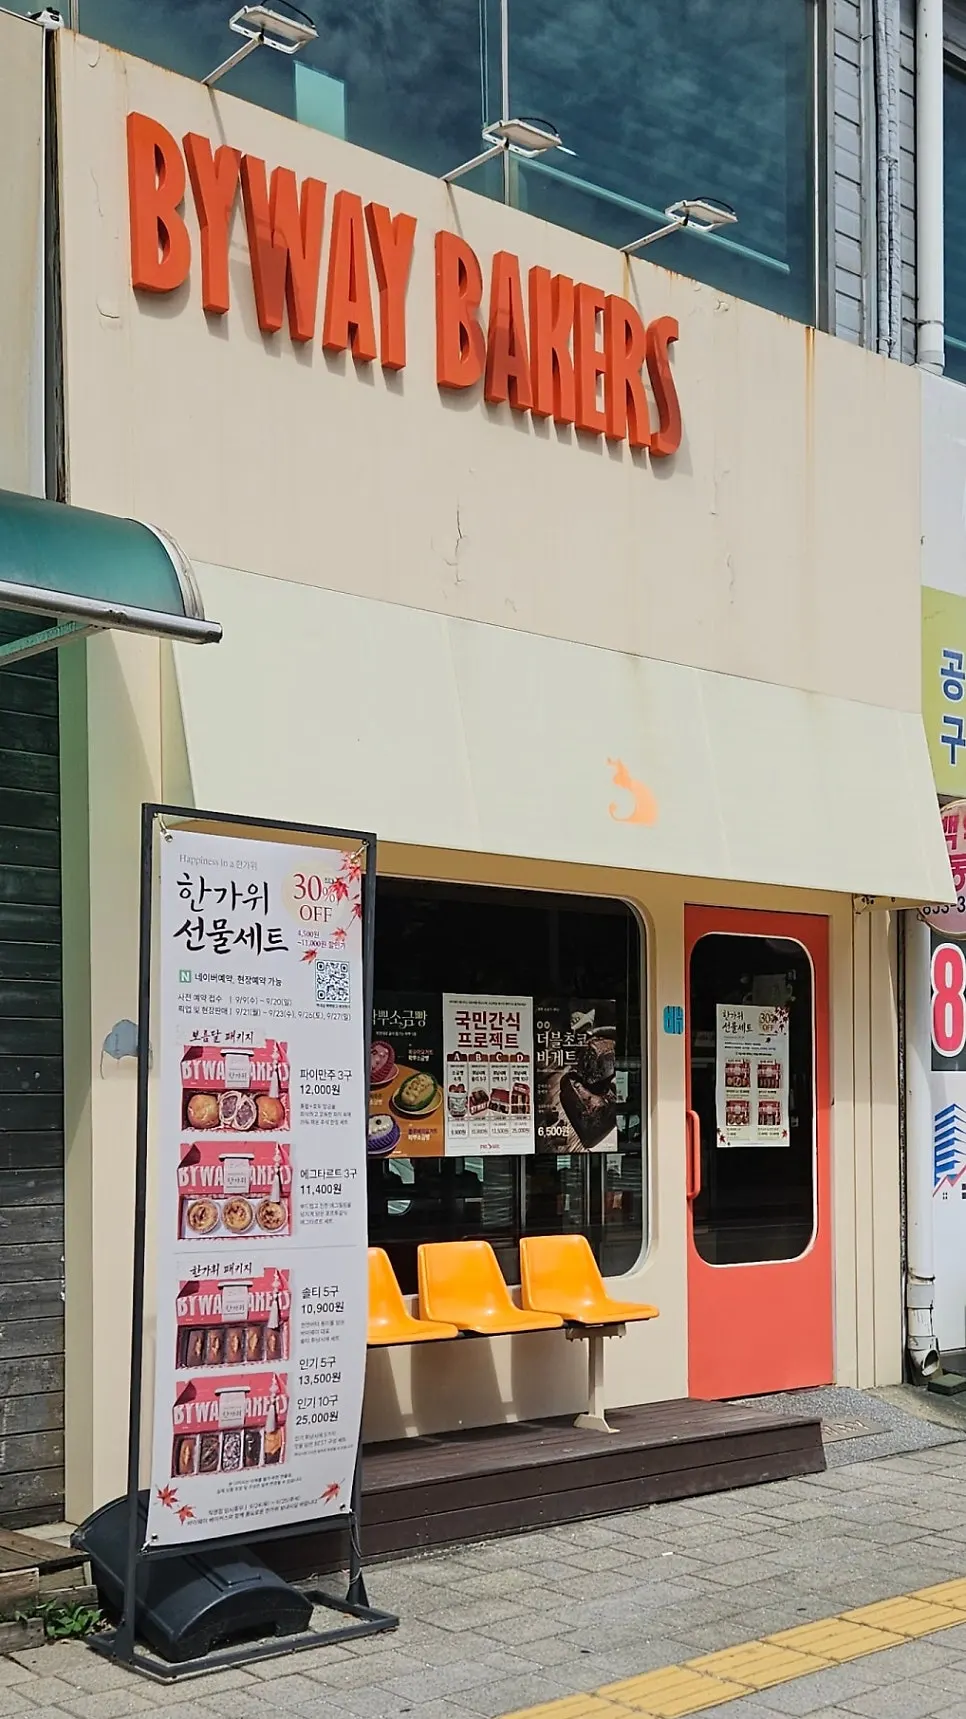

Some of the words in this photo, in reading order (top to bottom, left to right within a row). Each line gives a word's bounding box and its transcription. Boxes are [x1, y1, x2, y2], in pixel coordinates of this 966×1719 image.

[126, 111, 418, 371] BYWAY
[435, 229, 680, 459] BAKERS
[179, 854, 219, 866] Happiness
[177, 872, 268, 916] 한가위
[293, 873, 336, 903] 30%
[300, 904, 333, 923] OFF
[173, 916, 289, 957] 선물세트
[237, 975, 266, 986] 현장예약
[268, 977, 282, 987] 가능
[178, 993, 191, 1002] 사전
[932, 945, 965, 1054] 8
[455, 1010, 520, 1032] 국민간식
[722, 1010, 744, 1021] 한가위
[722, 1021, 754, 1034] 선물세트
[189, 1028, 222, 1044] 보름달
[224, 1029, 254, 1045] 패키지
[457, 1031, 519, 1051] 프로젝트
[536, 1031, 589, 1049] 더블초코
[453, 1053, 461, 1062] A
[475, 1053, 482, 1062] B
[495, 1053, 502, 1062] C
[516, 1054, 524, 1062] D
[536, 1049, 579, 1067] 바게트
[300, 1068, 336, 1081] 파이만주
[337, 1069, 353, 1082] 3구
[300, 1084, 341, 1096] 12,000원
[537, 1126, 569, 1139] 6,500원
[300, 1168, 343, 1180] 에그타르트
[344, 1168, 358, 1179] 3구
[300, 1183, 342, 1196] 11,400원
[189, 1262, 220, 1278] 한가위
[223, 1262, 252, 1276] 패키지
[302, 1285, 321, 1300] 솔티
[323, 1285, 339, 1298] 5구
[301, 1301, 345, 1315] 10,900원
[299, 1357, 318, 1371] 인기
[320, 1356, 336, 1369] 5구
[298, 1371, 341, 1386] 13,500원
[297, 1396, 316, 1410] 인기
[318, 1395, 339, 1408] 10구
[296, 1410, 339, 1426] 25,000원
